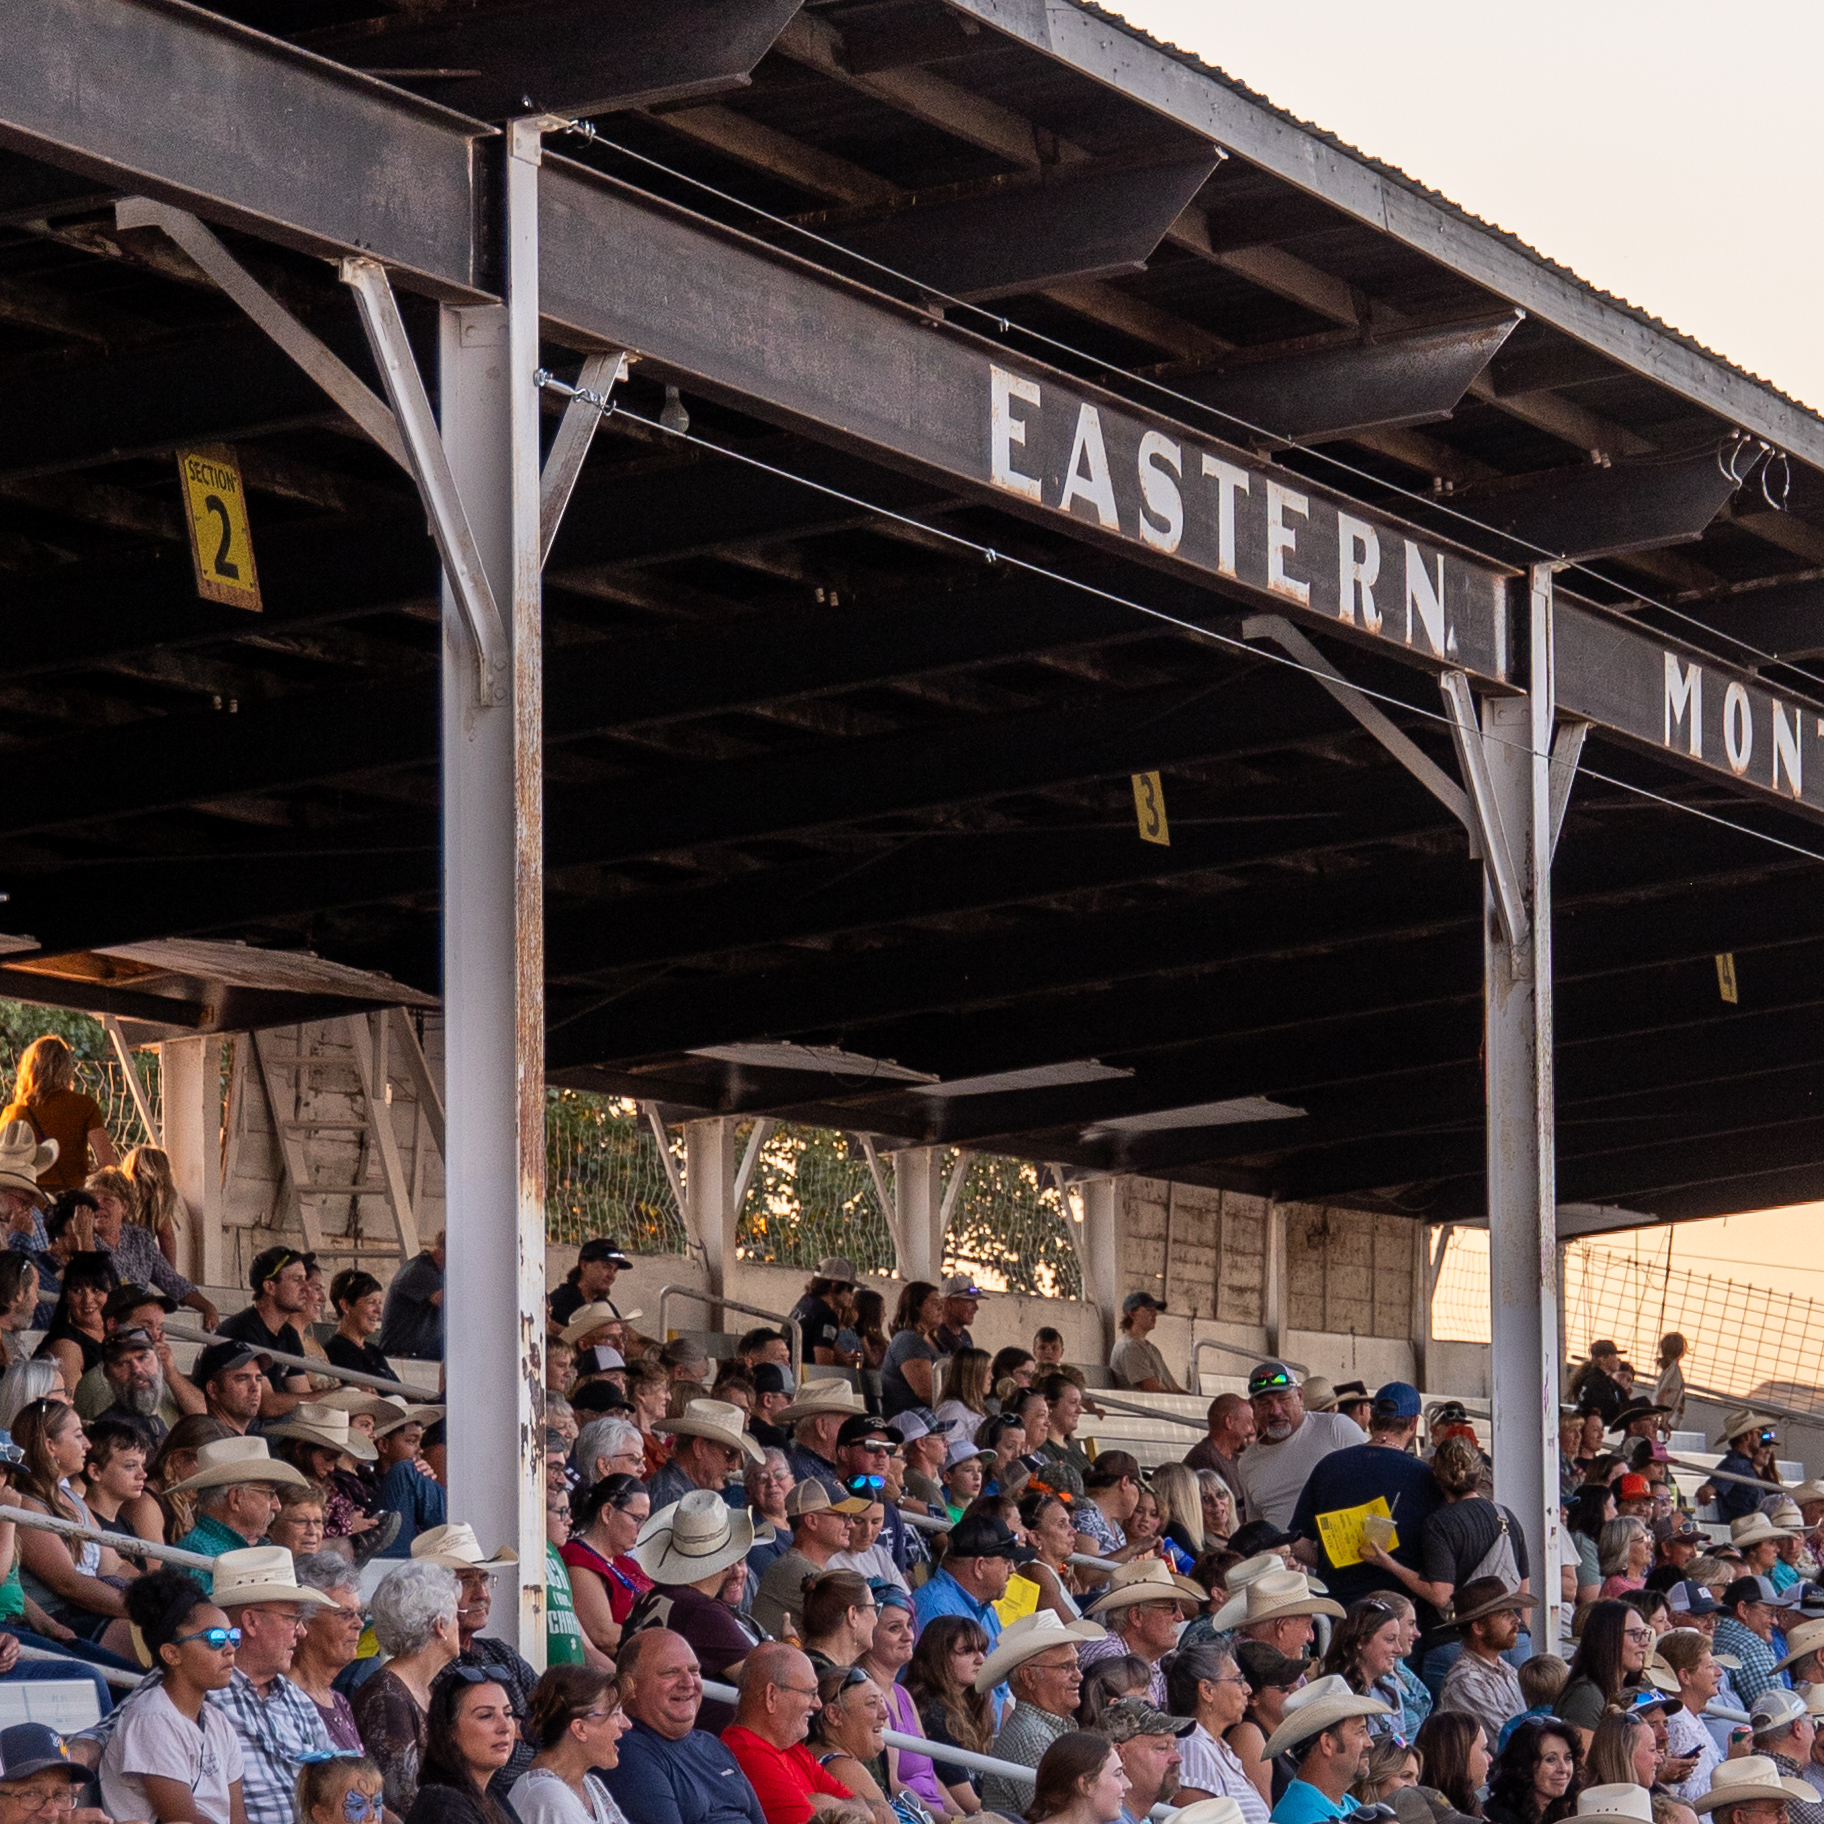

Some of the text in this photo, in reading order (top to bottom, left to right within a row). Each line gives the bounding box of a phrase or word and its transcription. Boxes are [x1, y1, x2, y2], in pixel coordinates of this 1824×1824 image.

[188, 460, 237, 493] SECTION
[205, 494, 240, 580] 2
[990, 363, 1446, 659] EASTERN
[1140, 773, 1160, 837] 3
[1721, 953, 1733, 997] 4
